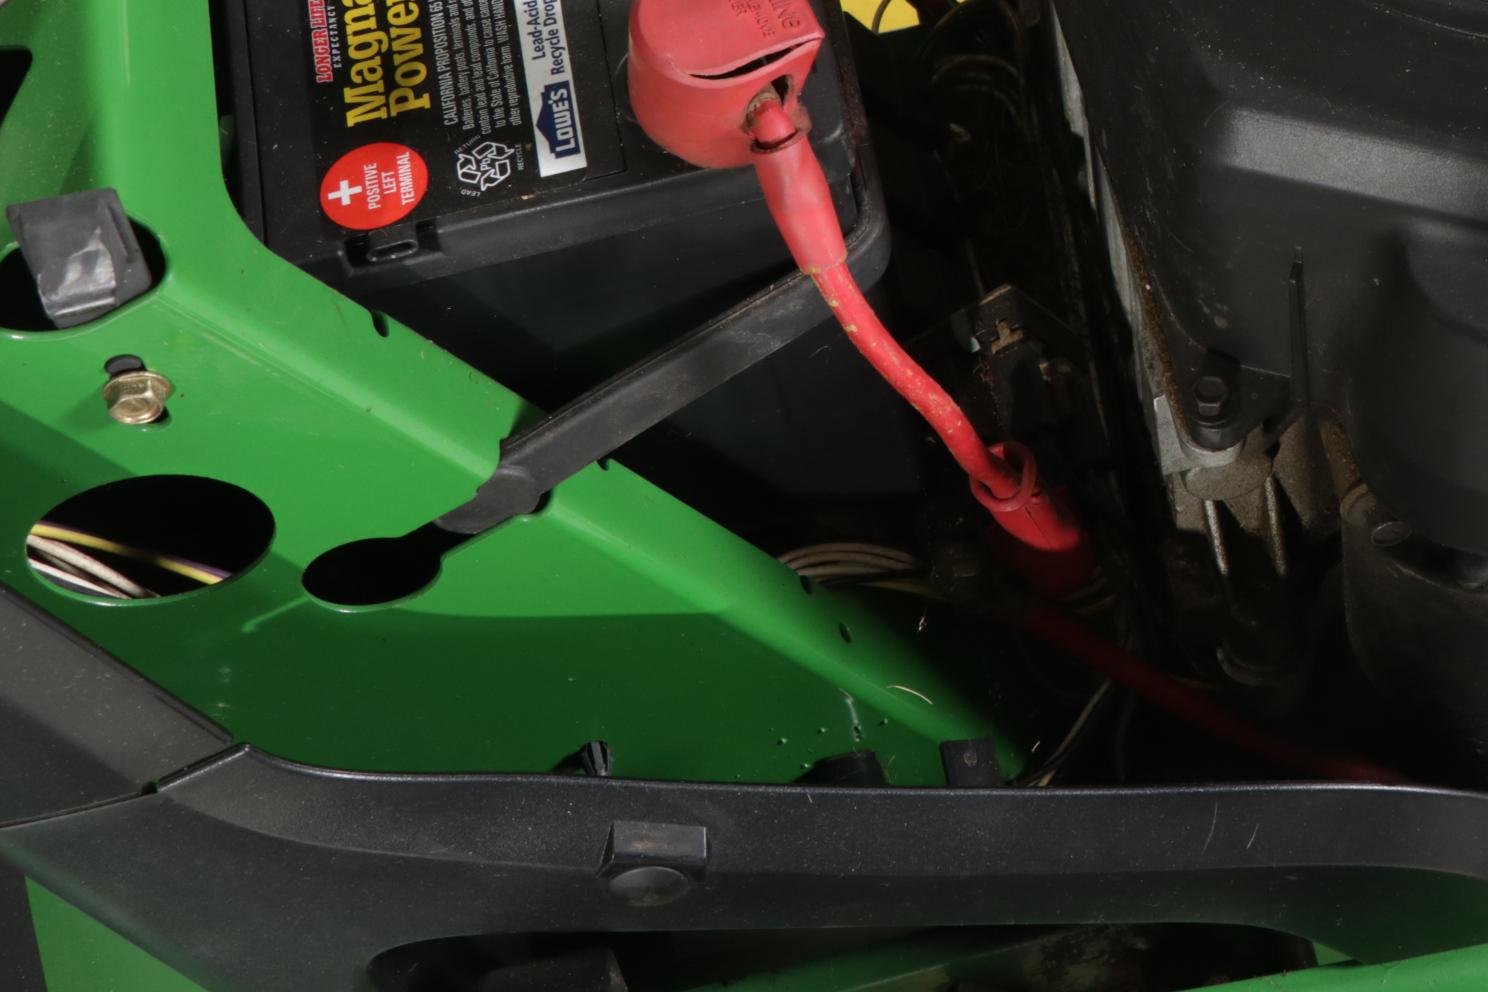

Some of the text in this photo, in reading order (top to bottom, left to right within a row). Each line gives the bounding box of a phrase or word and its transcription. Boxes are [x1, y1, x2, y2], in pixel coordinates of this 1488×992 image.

[429, 1, 443, 12] 65
[447, 3, 459, 16] and
[462, 6, 474, 20] and
[328, 5, 342, 68] EXPECTANCY
[449, 17, 463, 49] terminals
[481, 18, 492, 38] cause
[495, 19, 508, 42] WASH
[527, 0, 546, 60] Lead-Acid
[429, 12, 451, 72] PROPOSITION
[483, 38, 493, 46] to
[546, 28, 565, 75] Recycle
[312, 29, 333, 83] LONGER
[483, 46, 498, 80] California
[470, 62, 482, 78] lead
[456, 71, 472, 95] battery
[472, 78, 484, 91] and
[488, 79, 500, 87] of
[502, 63, 521, 106] reproductive
[437, 71, 458, 125] CALIFORNIA
[474, 92, 487, 108] lead
[489, 88, 503, 107] State
[477, 108, 491, 134] contain
[493, 107, 504, 119] the
[494, 119, 505, 127] to
[508, 106, 521, 125] other
[548, 85, 576, 152] LOWE'S
[480, 158, 491, 171] Pb
[515, 144, 524, 170] RECYCLE
[362, 162, 380, 210] POSITIVE
[381, 172, 397, 194] LEFT
[396, 152, 415, 206] TERMINAL
